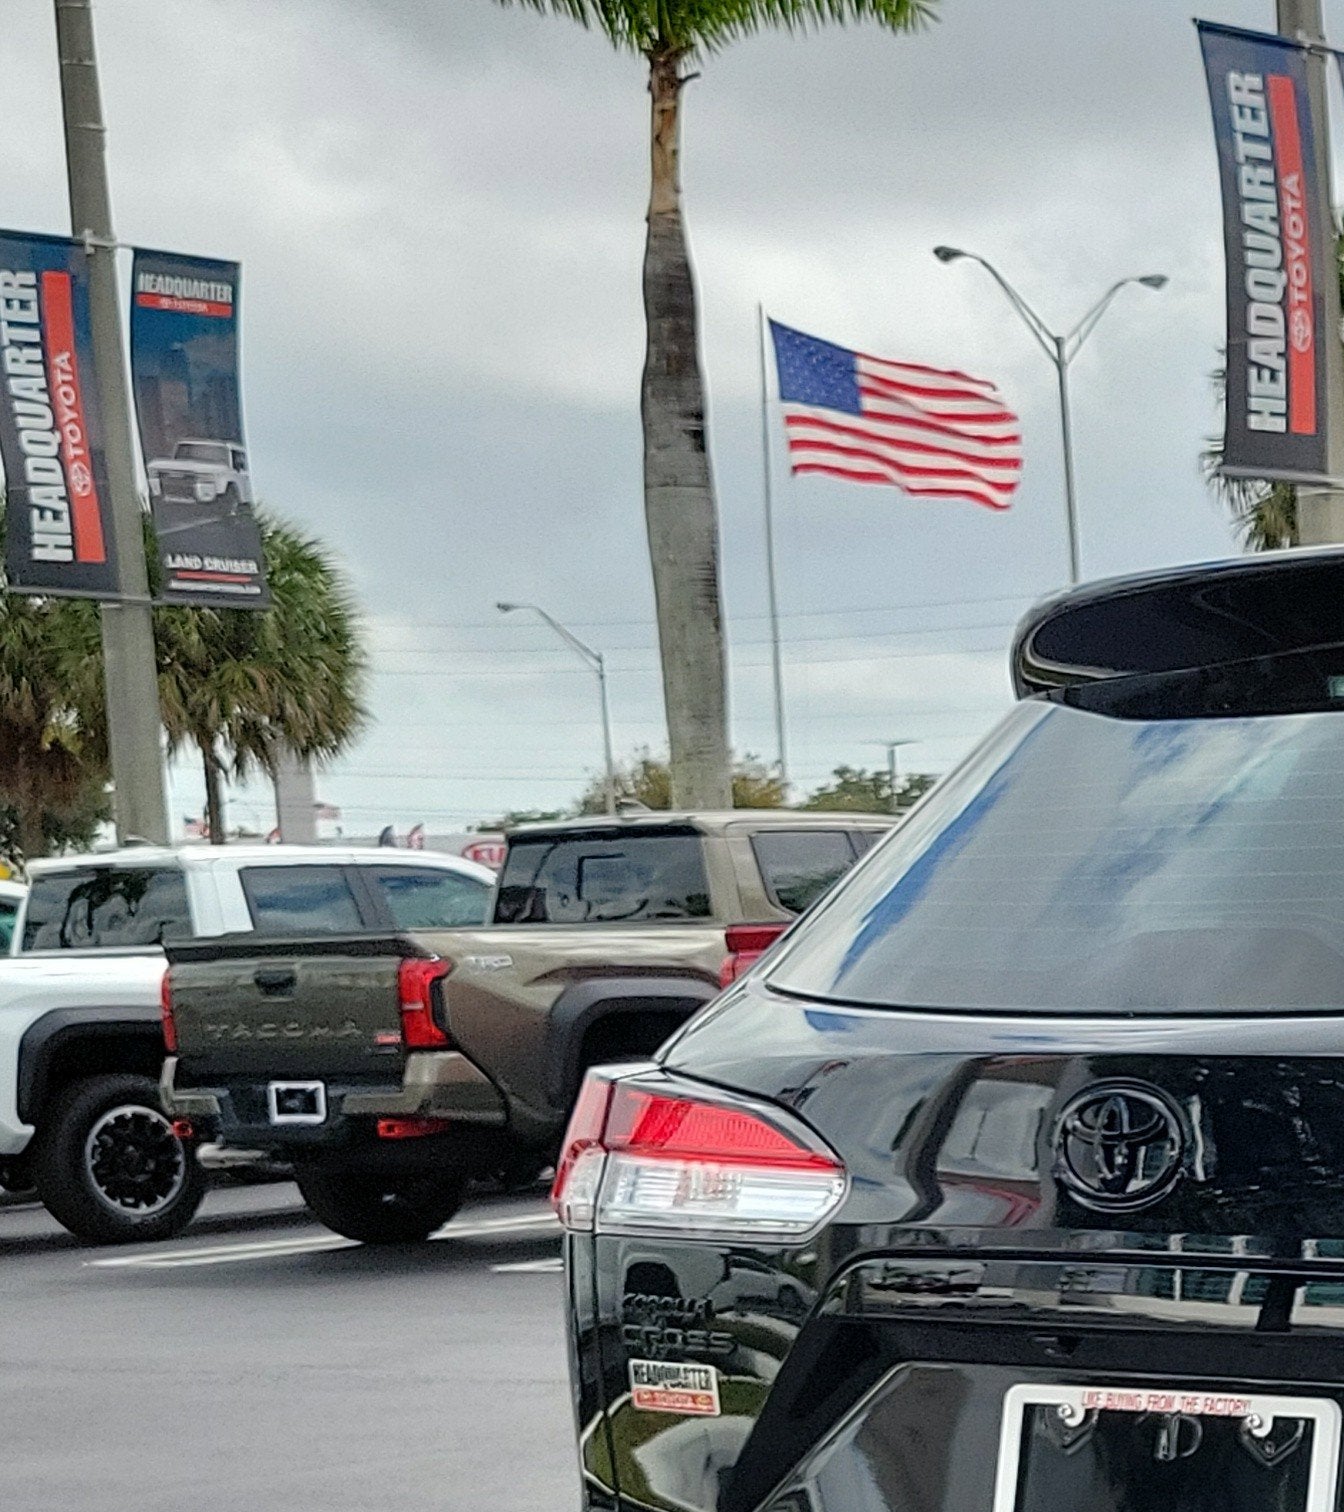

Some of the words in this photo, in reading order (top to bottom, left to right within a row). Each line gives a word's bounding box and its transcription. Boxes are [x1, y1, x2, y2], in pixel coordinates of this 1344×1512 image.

[1228, 72, 1288, 434] HEADQUARTER
[1281, 172, 1310, 309] TOYOTA
[139, 273, 232, 303] HEADQUARTER
[0, 269, 74, 562] HEADQUARTER
[52, 352, 85, 458] TOYOTA
[165, 554, 202, 569] LAND
[203, 556, 258, 574] CRUISER
[205, 1021, 363, 1040] TACOMA
[622, 1324, 734, 1354] CROSS
[1147, 1394, 1176, 1411] FROM
[1181, 1396, 1199, 1412] THE
[1203, 1397, 1250, 1415] FACTORY
